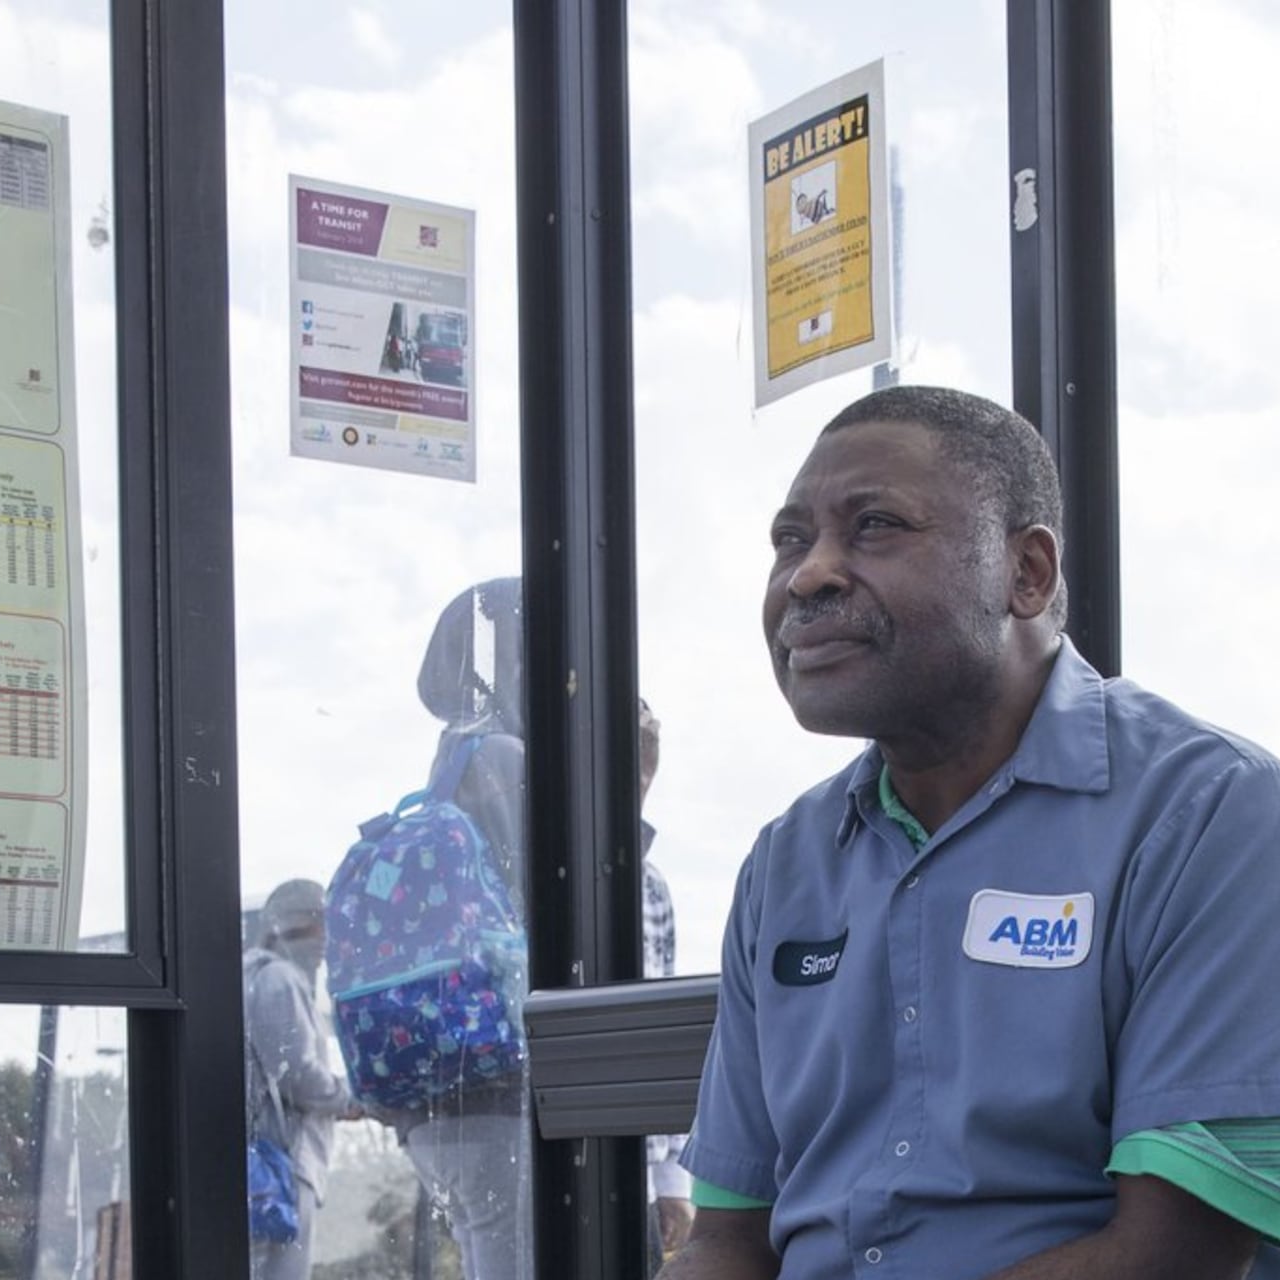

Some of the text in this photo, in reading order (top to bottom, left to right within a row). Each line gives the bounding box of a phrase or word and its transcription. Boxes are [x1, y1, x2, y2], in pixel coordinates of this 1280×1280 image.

[767, 106, 864, 178] BE ALERT!
[311, 201, 369, 219] A TIME FOR
[319, 216, 363, 231] TRANSIT
[988, 915, 1078, 946] ABM
